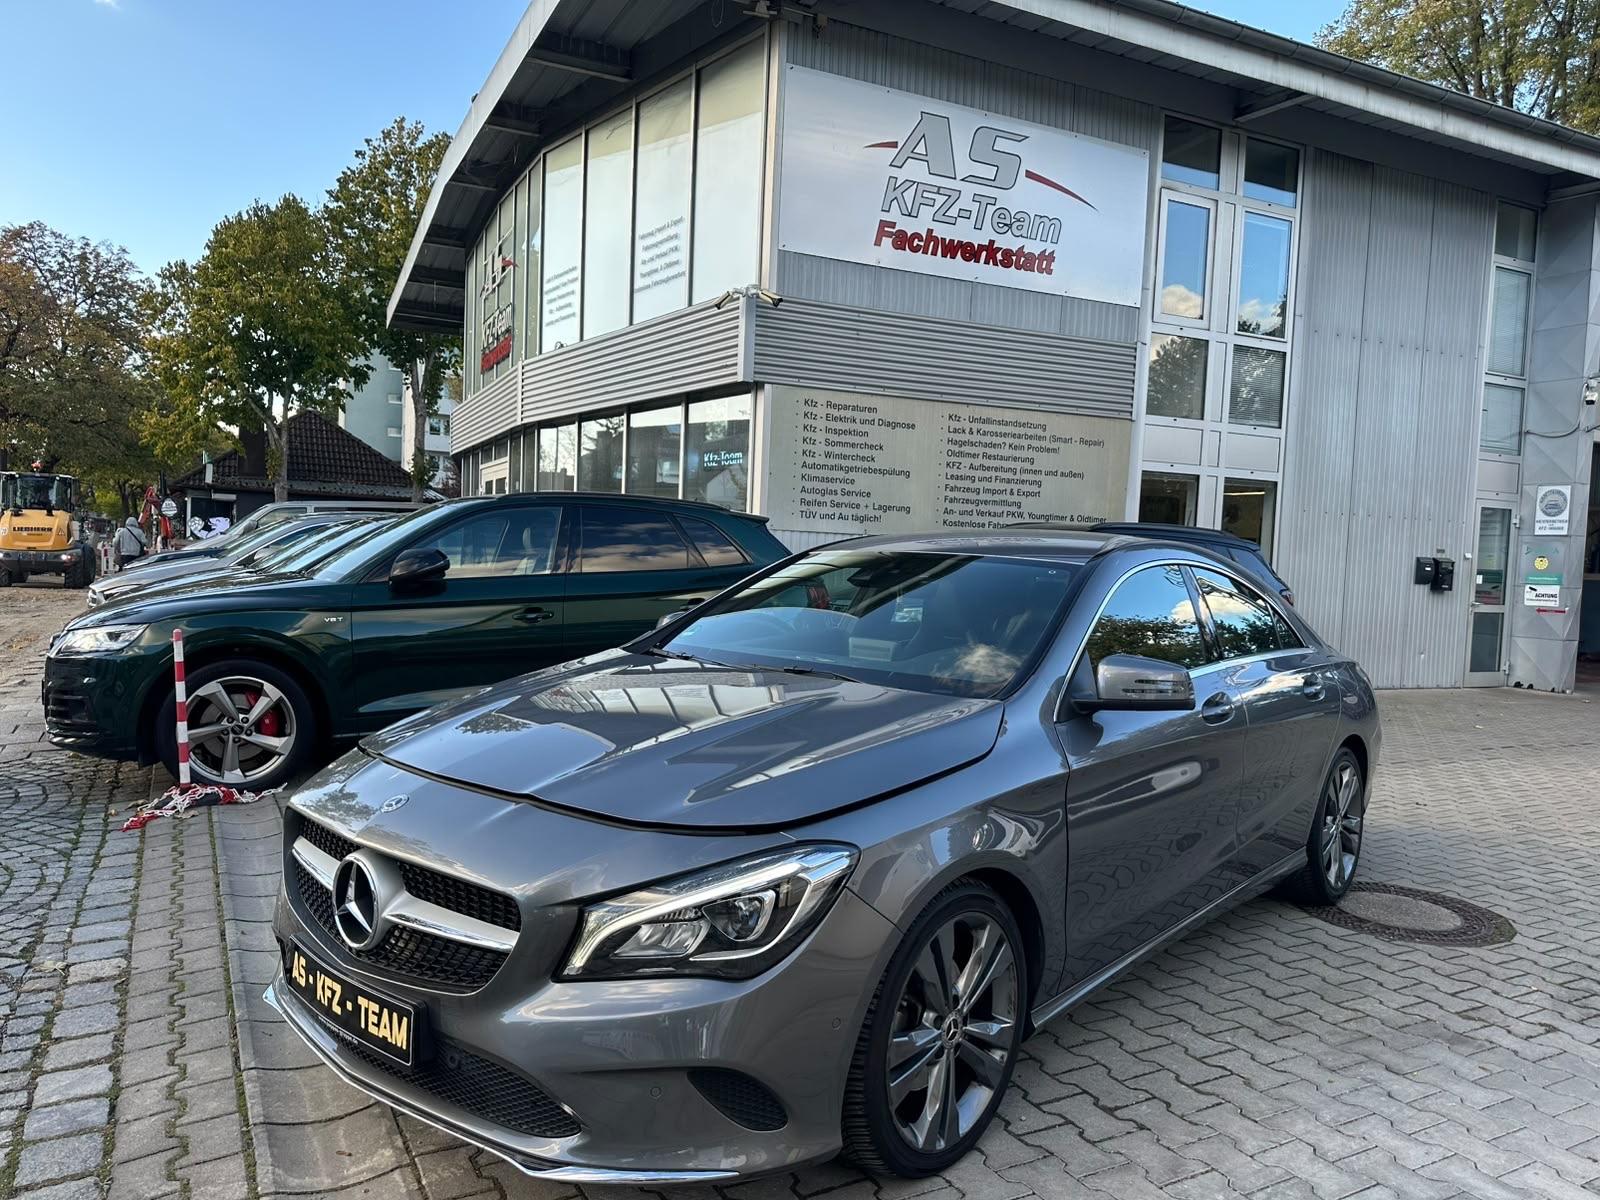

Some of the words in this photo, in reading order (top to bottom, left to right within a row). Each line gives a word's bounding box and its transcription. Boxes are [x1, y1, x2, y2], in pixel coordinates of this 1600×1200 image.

[889, 111, 1030, 190] AS
[881, 176, 1062, 244] KFZ-Team
[873, 220, 1056, 275] Fachwerkstatt
[804, 398, 818, 408] Kfz
[826, 400, 878, 414] Reparaturen
[804, 411, 818, 420] Kfz
[826, 414, 857, 424] Elektrik
[860, 418, 875, 426] und
[878, 418, 916, 430] Diagnose
[948, 414, 961, 422] Kfz
[968, 416, 1047, 432] Unfallinstandsetzung
[803, 424, 817, 433] Kfz
[825, 426, 868, 438] Inspektion
[948, 426, 966, 435] Lack
[976, 428, 1047, 442] Karosseriearbeiten
[1049, 435, 1072, 445] (Smart
[1079, 438, 1105, 448] Repair)
[802, 436, 816, 446] Kfz
[824, 438, 884, 451] Sommercheck
[947, 438, 1006, 449] Hagelschaden?
[1008, 443, 1025, 451] Kein
[1027, 444, 1060, 454] Problem!
[802, 449, 816, 458] Kfz
[824, 451, 875, 463] Wintercheck
[947, 450, 980, 459] Oldtimer
[982, 452, 1034, 465] Restaurierung
[801, 461, 910, 479] Automatikgetriebespülung
[946, 461, 962, 470] KFZ
[969, 463, 1017, 475] Aufbereitung
[1019, 467, 1042, 476] (innen
[1045, 468, 1058, 477] und
[1060, 471, 1085, 480] außen)
[801, 473, 856, 484] Klimaservice
[945, 472, 976, 483] Leasing
[978, 475, 992, 483] und
[994, 476, 1042, 488] Finanzierung
[800, 486, 838, 497] Autoglas
[840, 488, 871, 498] Service
[944, 484, 980, 495] Fahrzeug
[982, 486, 1007, 497] Import
[1017, 488, 1040, 498] Export
[800, 498, 827, 507] Reifen
[830, 500, 860, 509] Service
[872, 503, 911, 514] Lagerung
[944, 496, 1022, 508] Fahrzeugvermittlung
[800, 508, 817, 519] TÜV
[820, 512, 835, 520] und
[852, 514, 882, 524] täglich!
[943, 519, 985, 528] Kostenlose
[976, 509, 1004, 518] Verkauf
[1028, 512, 1067, 522] Youngtimer
[1077, 515, 1106, 524] Oldtimer
[292, 950, 306, 987] AS
[316, 970, 342, 1016] KFZ
[357, 995, 408, 1050] TEAM
